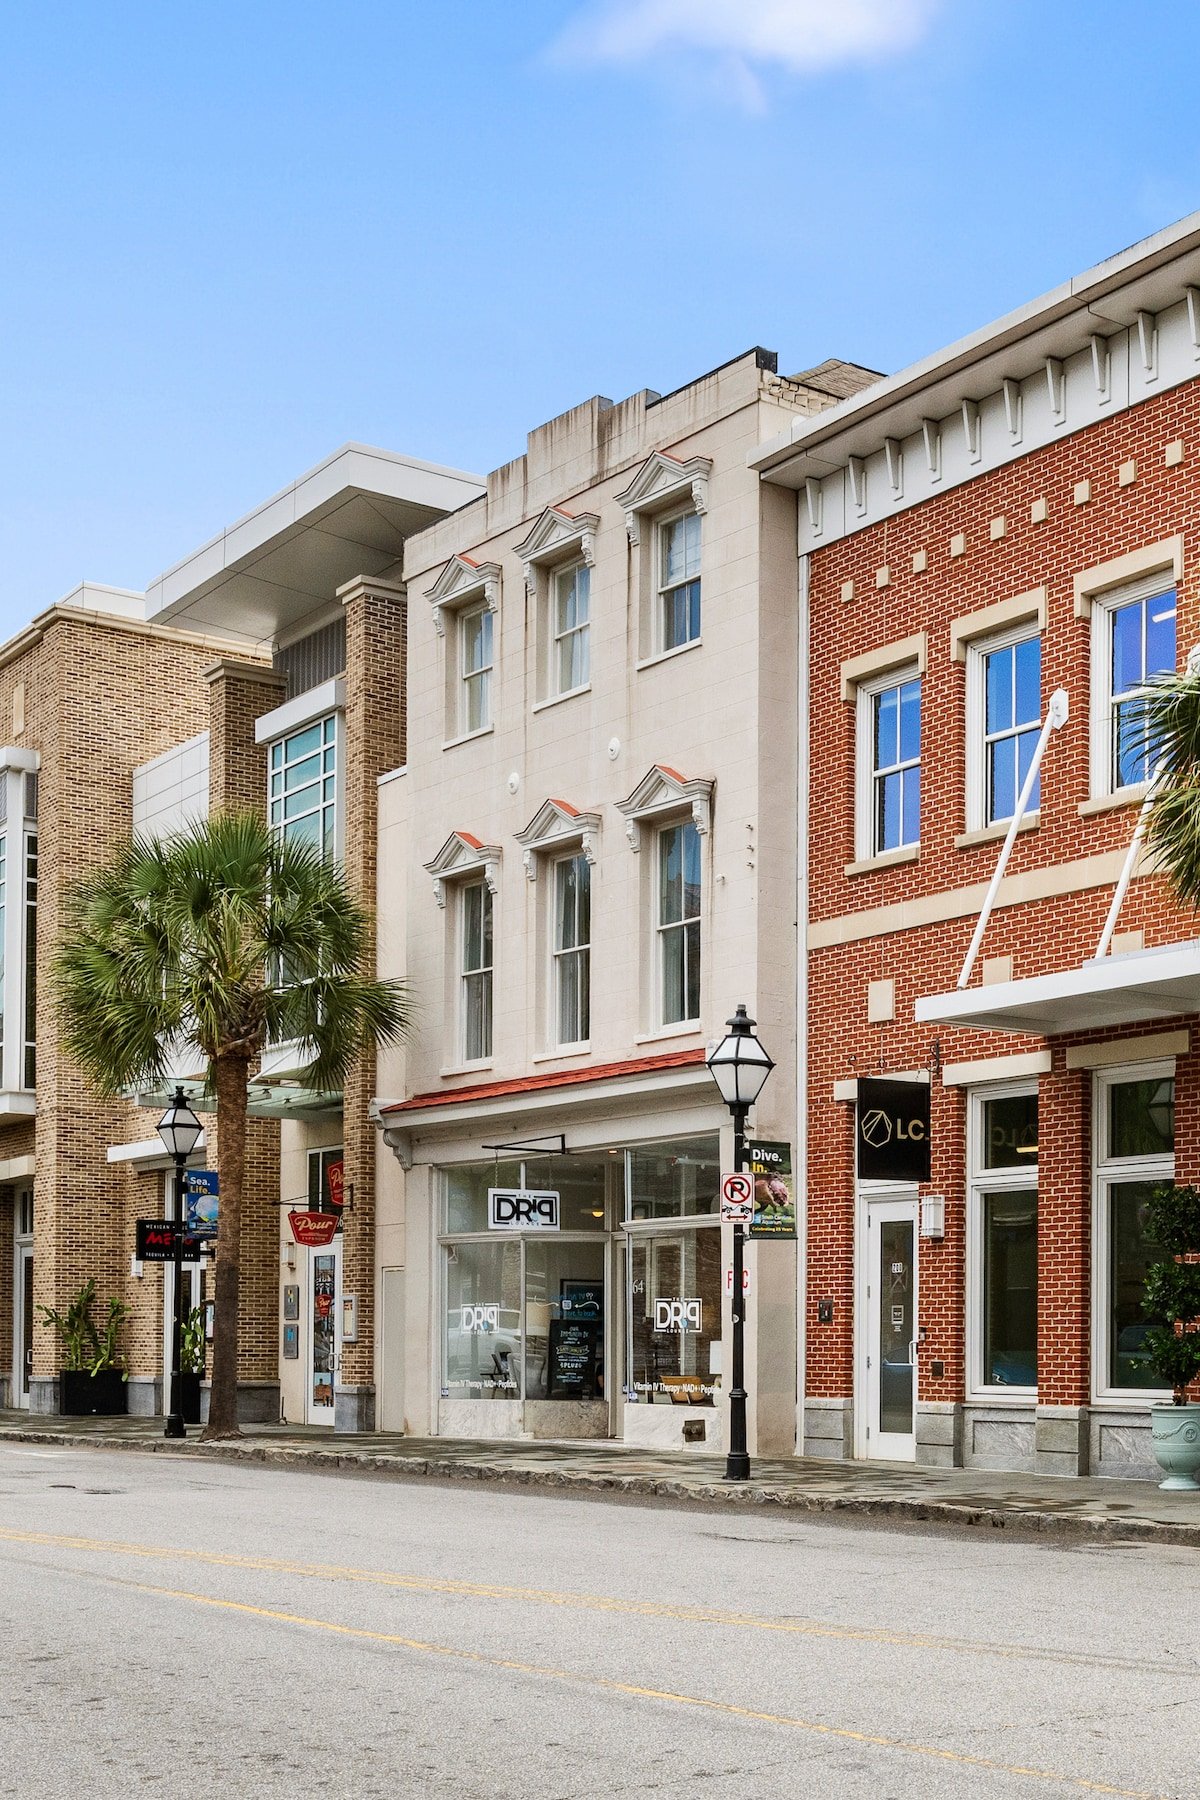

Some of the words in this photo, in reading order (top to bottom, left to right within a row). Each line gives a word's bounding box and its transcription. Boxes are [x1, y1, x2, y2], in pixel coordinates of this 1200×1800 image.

[752, 1149, 782, 1162] Dive.
[752, 1162, 768, 1173] In.
[190, 1177, 211, 1186] Sea.
[190, 1186, 211, 1195] Life.
[497, 1198, 554, 1222] DRIP
[294, 1216, 333, 1231] Pour
[632, 1279, 644, 1294] 64
[727, 1270, 749, 1289] FC
[463, 1307, 498, 1331] DRIP
[656, 1301, 700, 1329] DRIP
[633, 1381, 653, 1391] Vitamin
[653, 1382, 659, 1391] IV
[659, 1382, 680, 1394] Therapy
